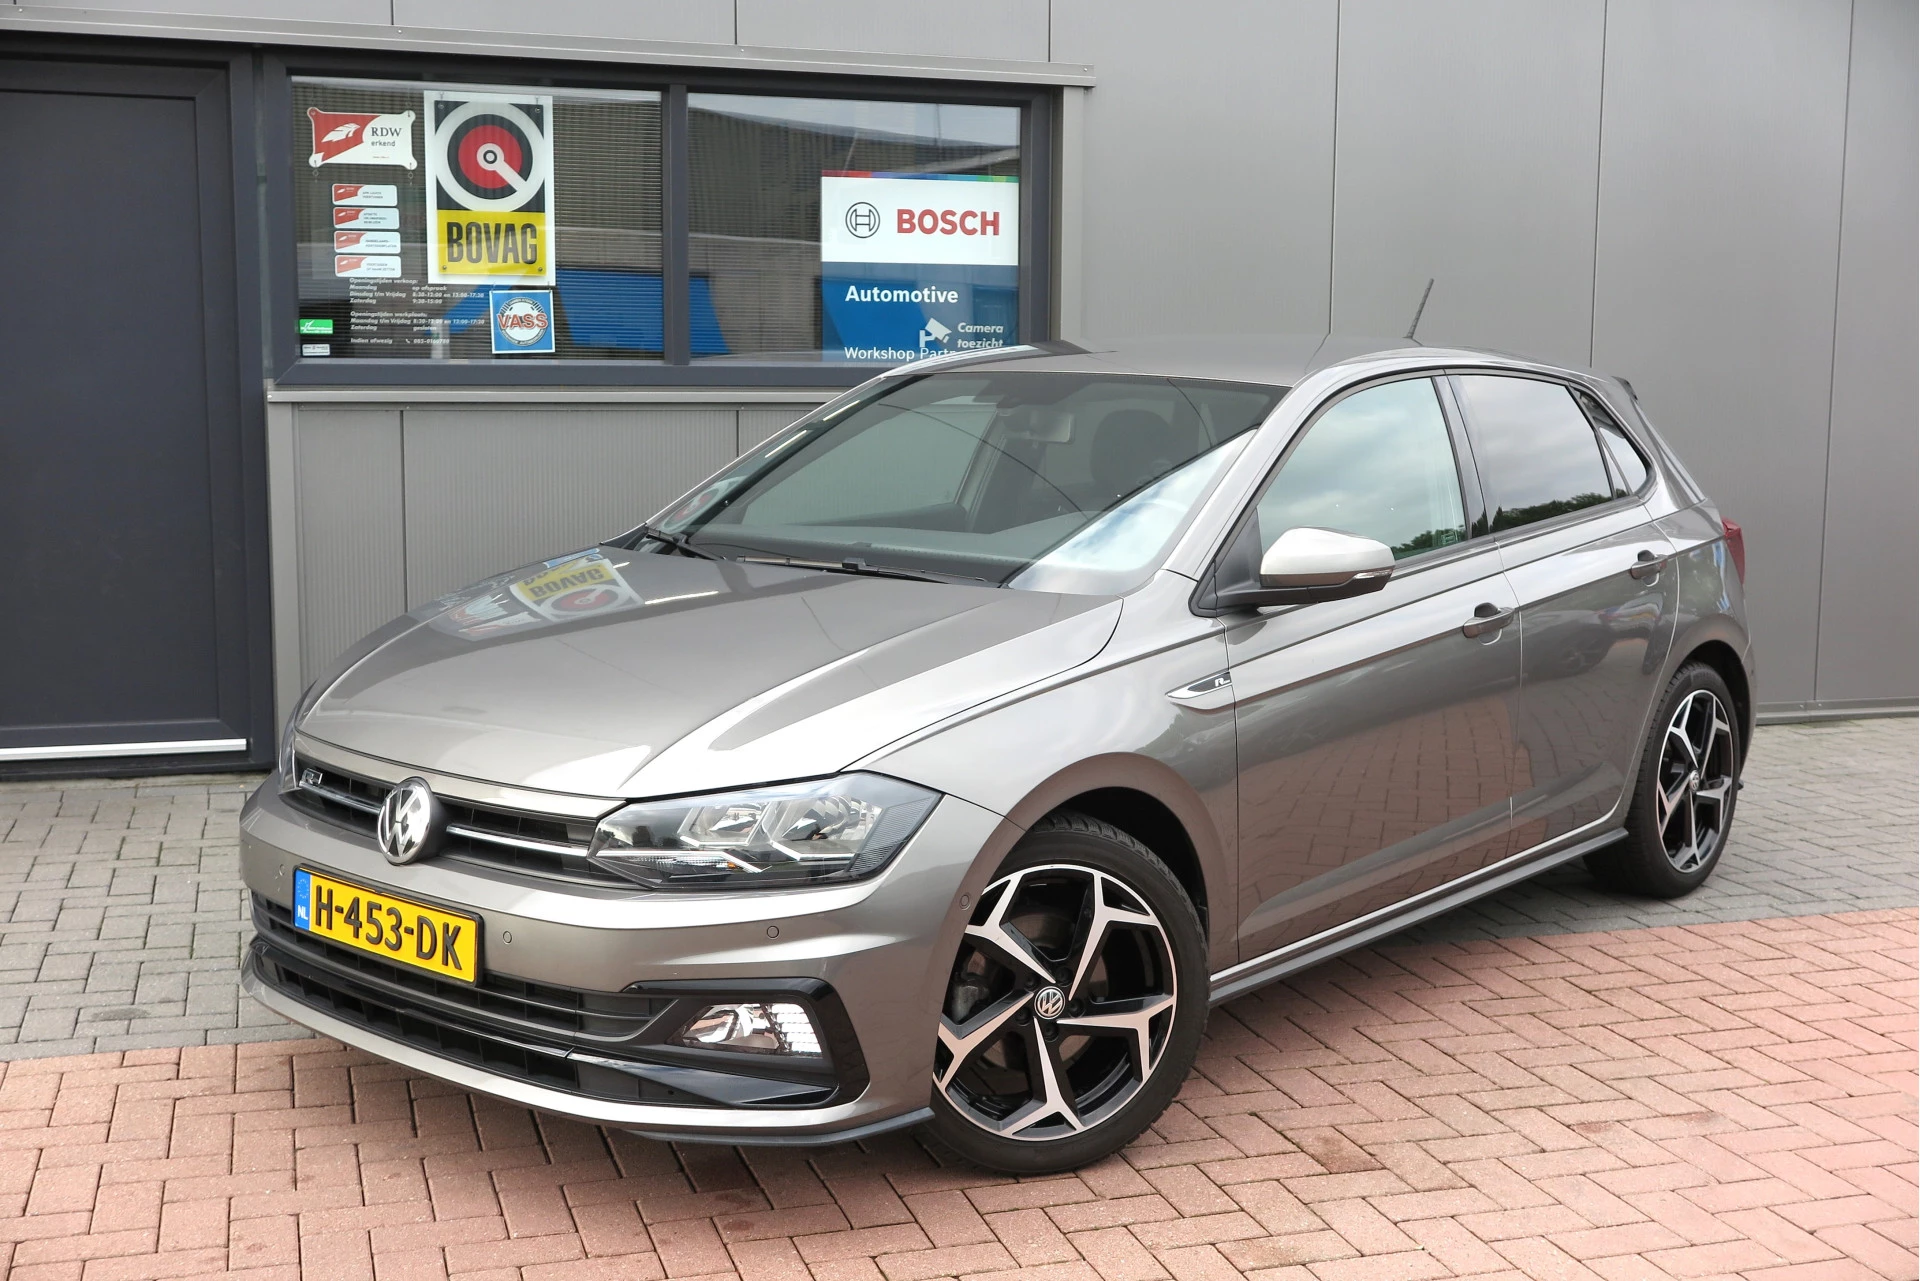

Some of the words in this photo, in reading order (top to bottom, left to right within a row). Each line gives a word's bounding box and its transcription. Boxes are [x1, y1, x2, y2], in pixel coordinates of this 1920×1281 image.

[371, 127, 402, 137] RDW
[897, 209, 1000, 236] BOSCH
[446, 221, 538, 264] BOVAG
[349, 277, 393, 285] Openingstijden
[845, 285, 959, 303] Automotive
[496, 312, 548, 330] VASS
[957, 322, 1004, 333] Camera
[957, 338, 1004, 349] toezicht
[844, 346, 915, 361] Workshop
[920, 347, 957, 359] Part
[297, 904, 309, 921] NL
[315, 884, 462, 971] H-453-DK
